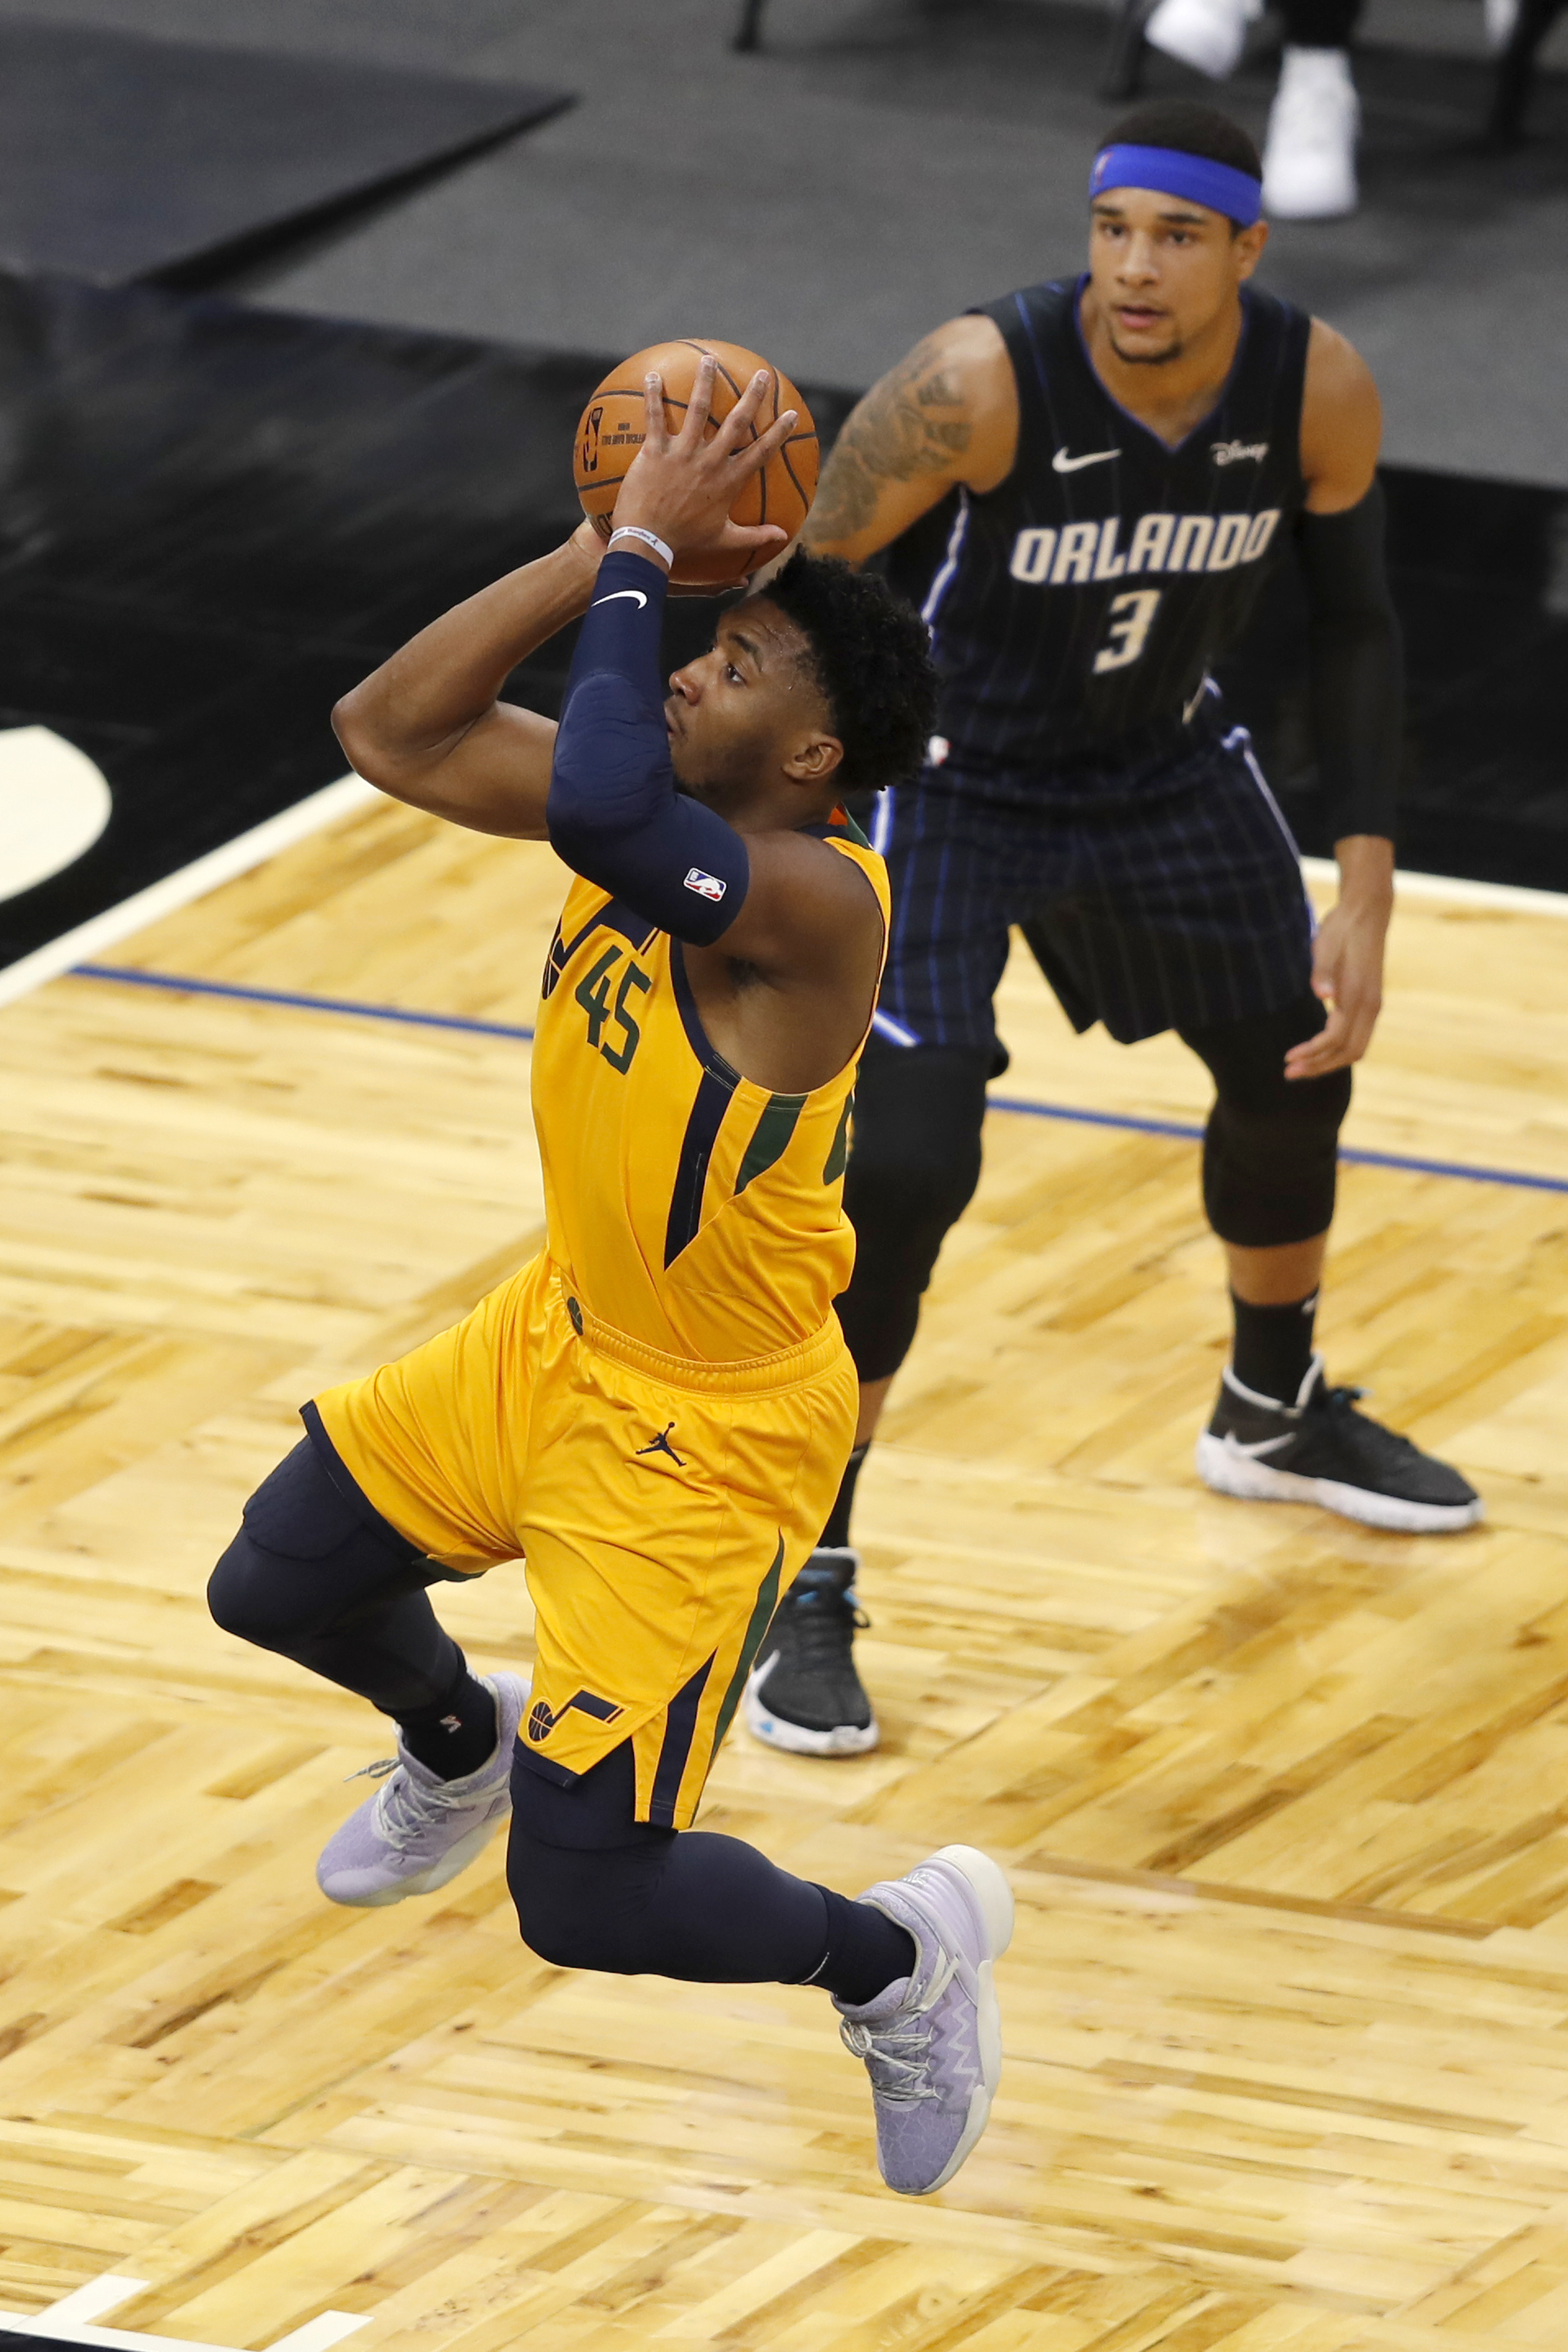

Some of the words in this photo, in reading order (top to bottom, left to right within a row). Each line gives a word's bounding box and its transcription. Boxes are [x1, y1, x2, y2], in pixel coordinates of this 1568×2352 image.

[1210, 439, 1268, 466] Disney
[1009, 509, 1281, 584] ORLANDO
[1092, 588, 1161, 673] 3
[574, 945, 652, 1076] 45
